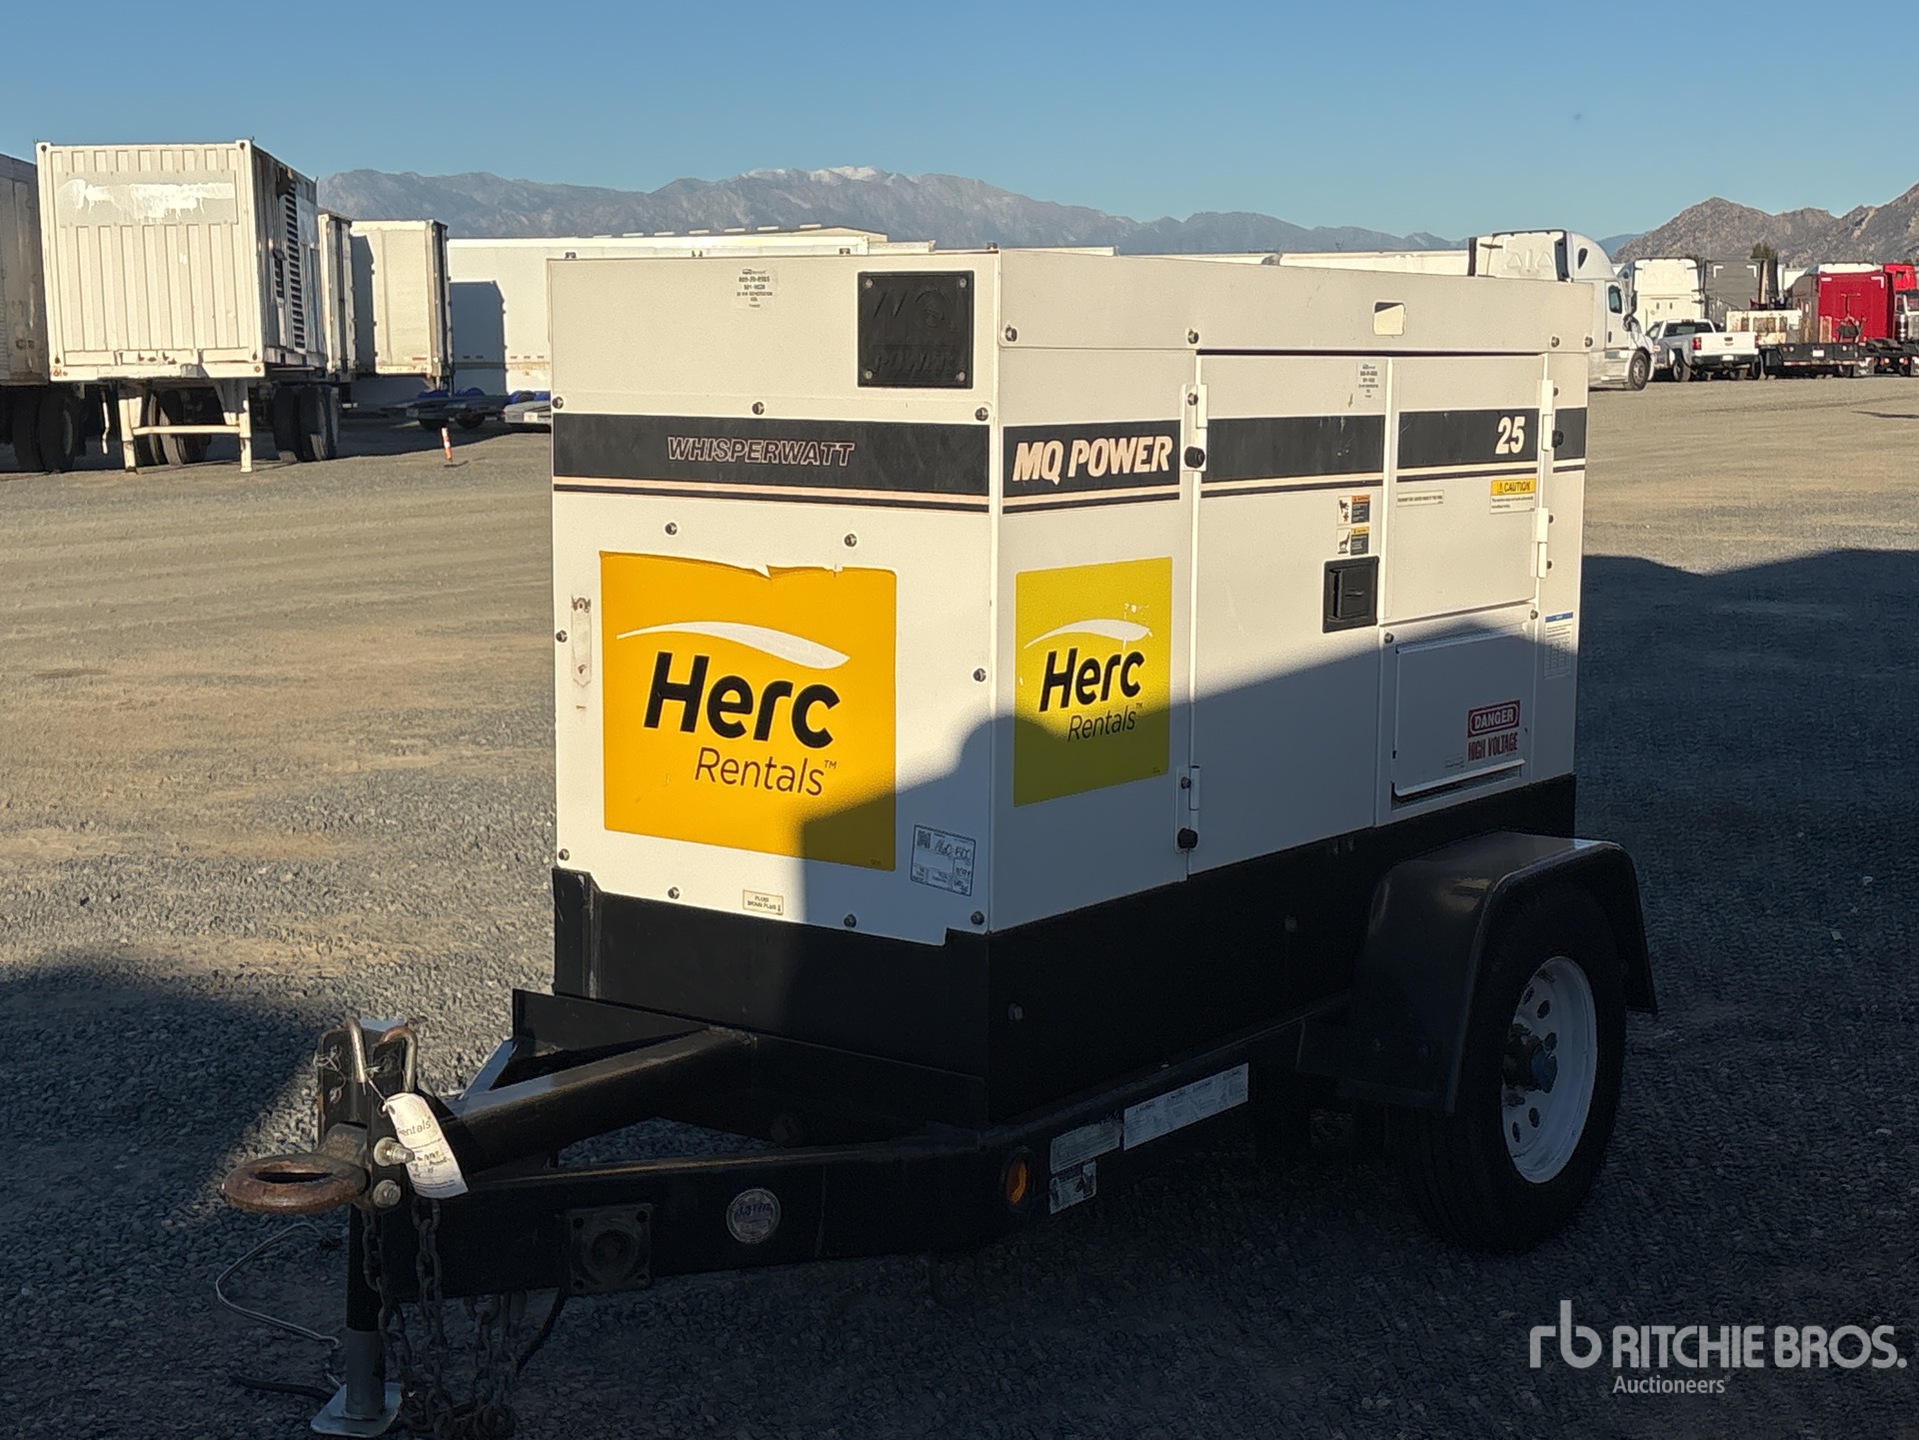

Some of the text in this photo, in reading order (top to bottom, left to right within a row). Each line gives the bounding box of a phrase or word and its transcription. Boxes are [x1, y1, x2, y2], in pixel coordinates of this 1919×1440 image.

[667, 436, 855, 467] WHISPERWATT
[1495, 416, 1526, 454] 25
[1012, 436, 1174, 486] MQ POWER
[1504, 481, 1531, 493] CAUTION
[1038, 647, 1145, 712] Herc
[643, 651, 841, 749] Herc
[1474, 708, 1514, 729] DANGER
[1488, 732, 1518, 757] VOLTAGE
